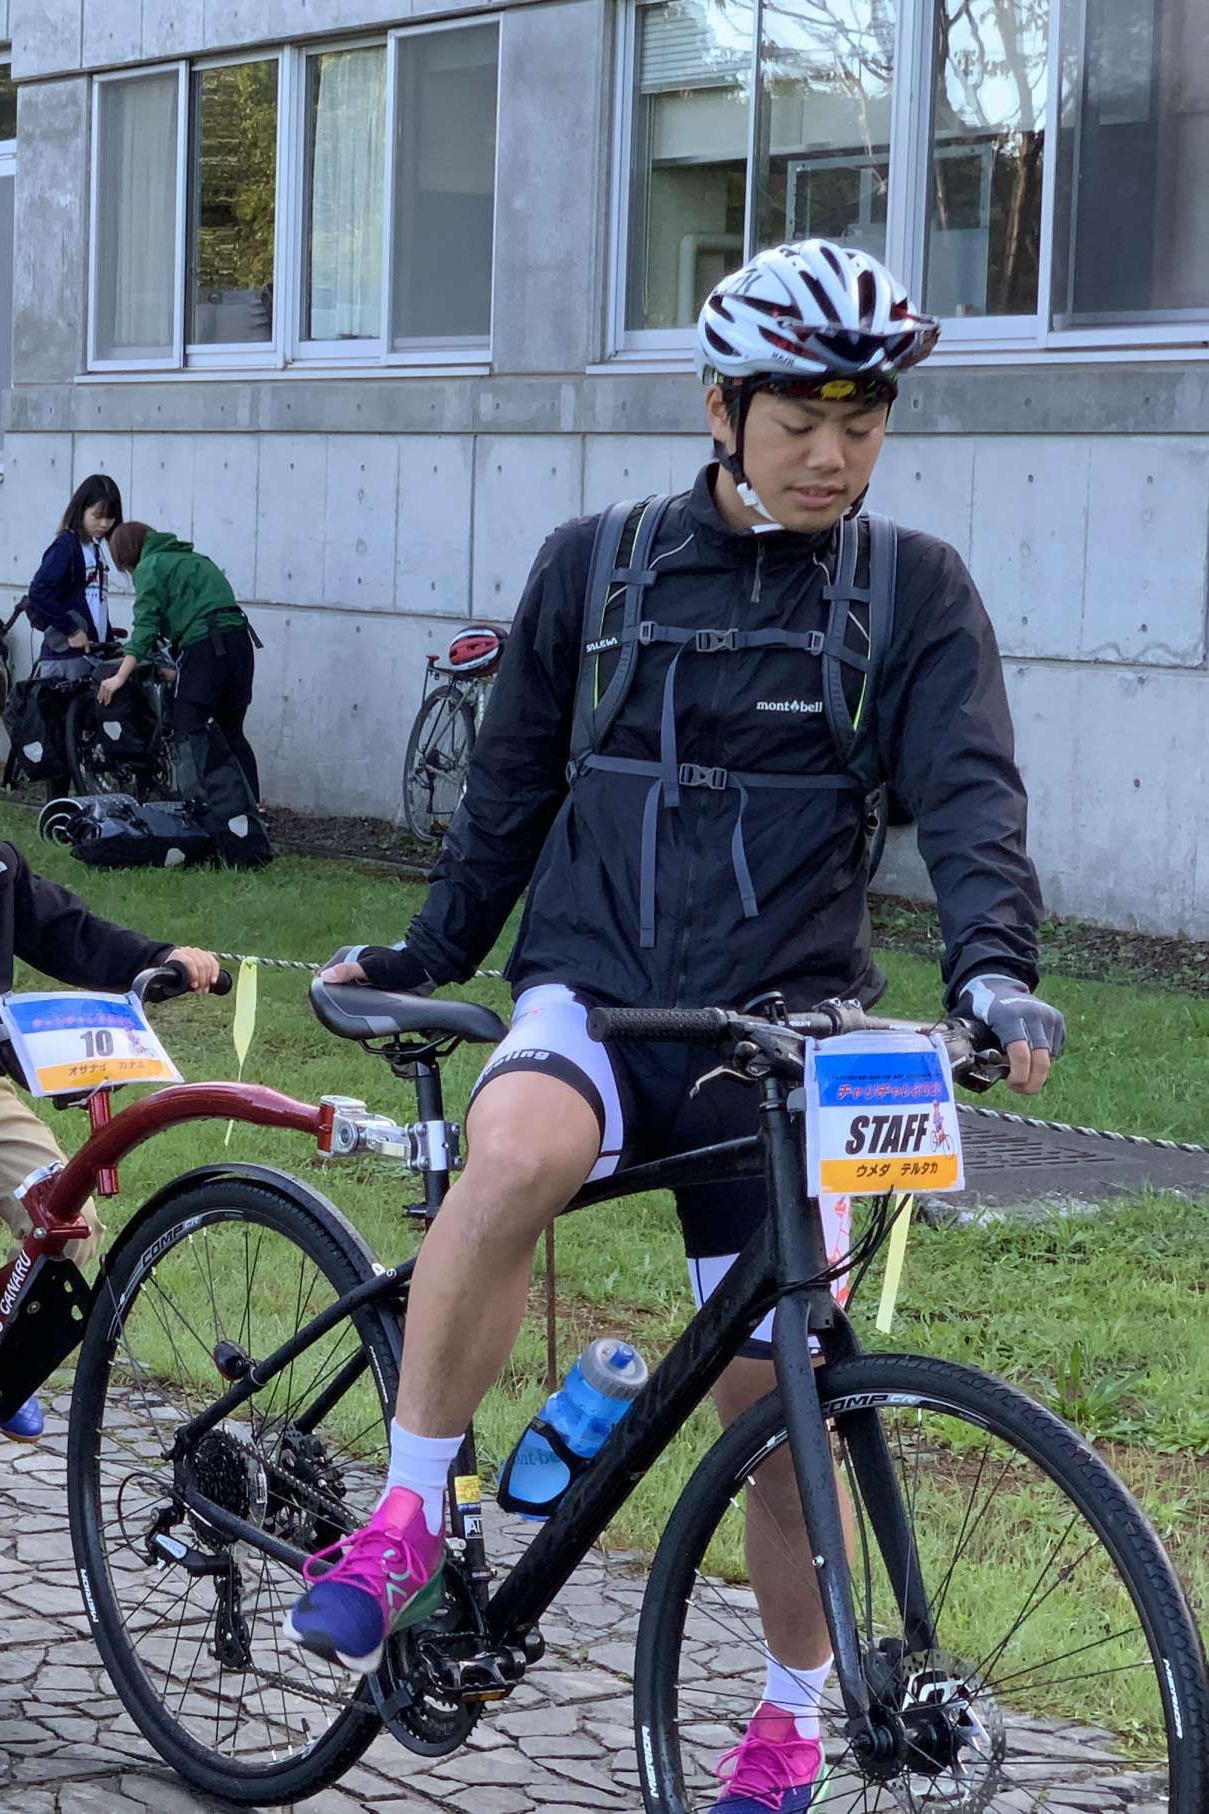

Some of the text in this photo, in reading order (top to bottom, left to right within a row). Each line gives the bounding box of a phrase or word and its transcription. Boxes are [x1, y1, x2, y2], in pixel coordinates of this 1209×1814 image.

[586, 637, 618, 653] SALEWA
[80, 1030, 113, 1057] 10
[845, 1113, 930, 1155] STAFF
[856, 1162, 939, 1178] ウメダ テルタカ
[142, 1224, 183, 1267] COMP
[0, 1250, 32, 1315] CANARU
[80, 1568, 100, 1623] MERIDA
[1163, 1658, 1183, 1739] MERIDA
[641, 1725, 660, 1798] MERIDA
